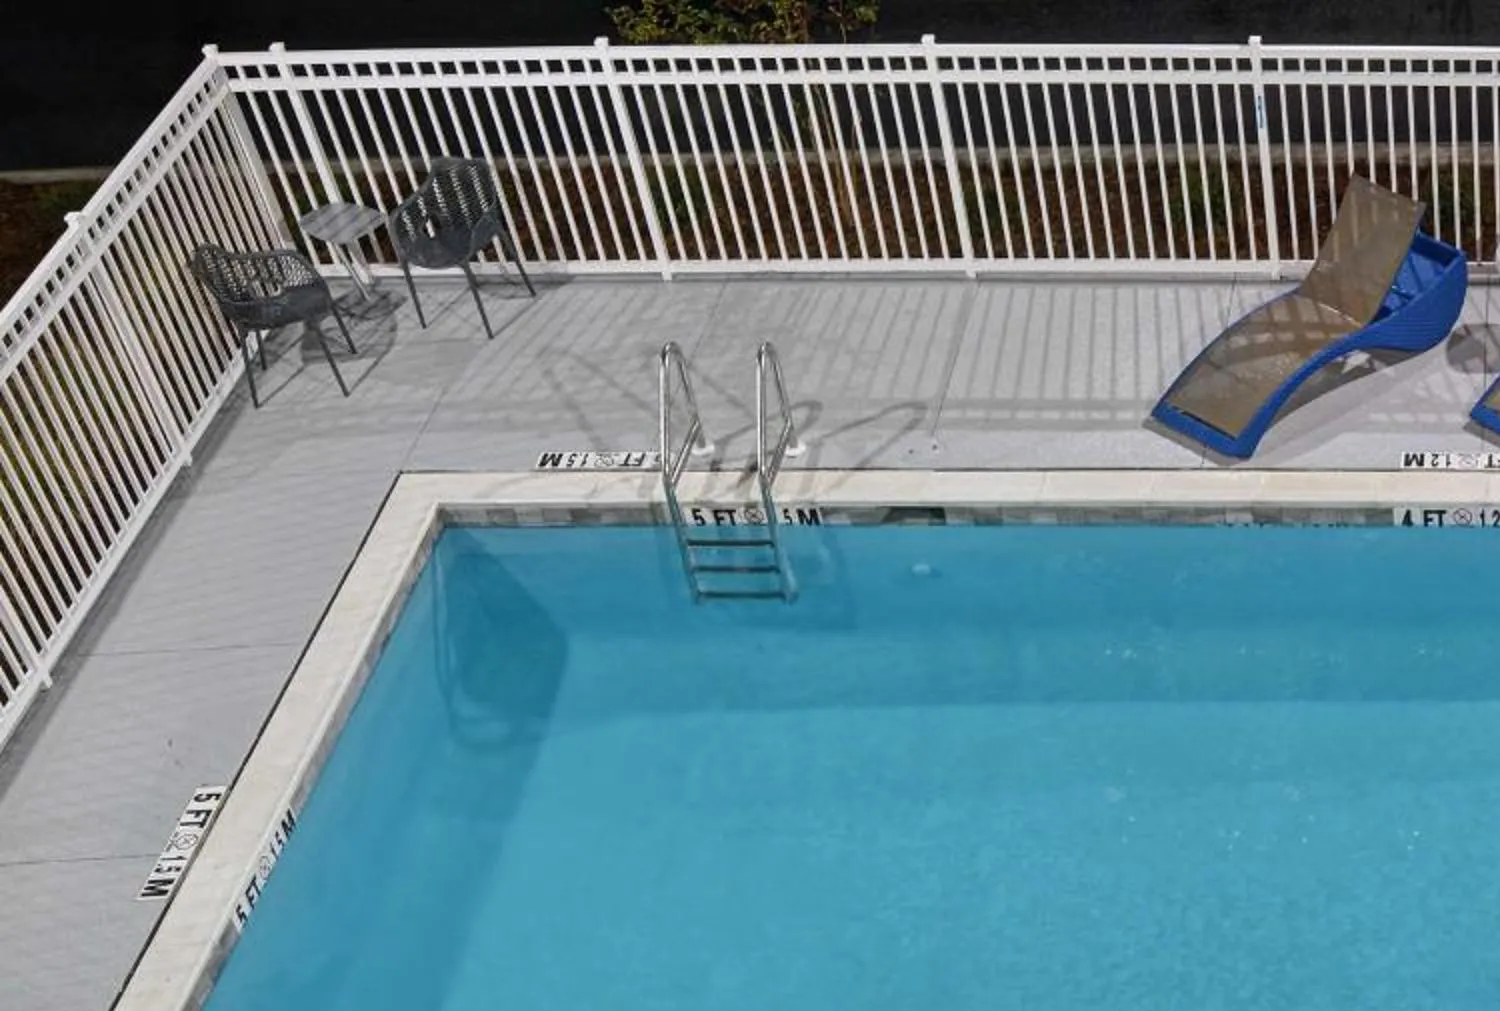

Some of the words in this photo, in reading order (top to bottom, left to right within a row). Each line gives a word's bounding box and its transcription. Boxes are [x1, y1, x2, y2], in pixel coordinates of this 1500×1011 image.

[538, 452, 563, 467] M
[619, 453, 646, 467] FT
[1403, 453, 1425, 467] M
[692, 508, 707, 527] 5
[713, 509, 737, 527] FT
[796, 508, 821, 526] M
[1402, 509, 1414, 528] 4
[1423, 509, 1447, 528] FT
[193, 793, 222, 803] 5
[179, 809, 213, 829] FT
[245, 874, 262, 910] FT
[281, 807, 297, 841] M
[141, 878, 175, 897] M
